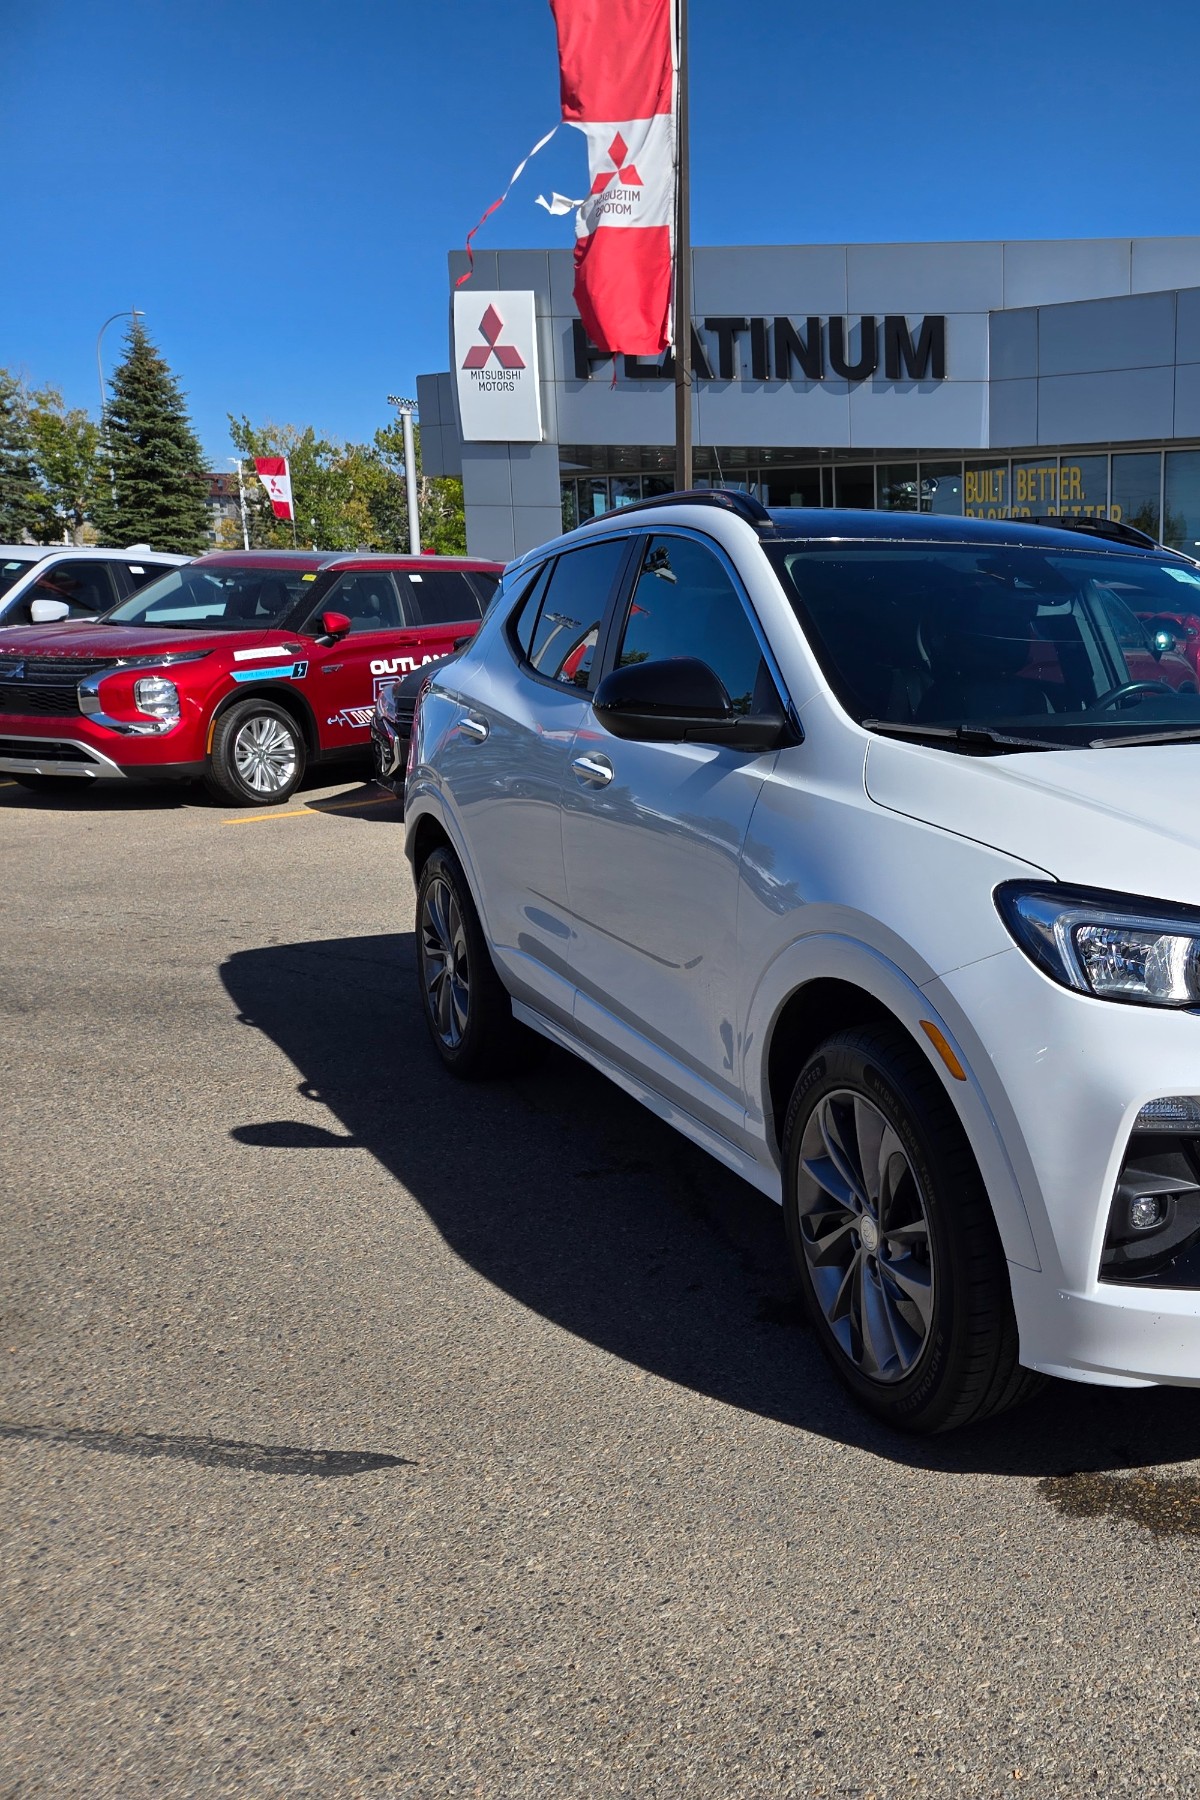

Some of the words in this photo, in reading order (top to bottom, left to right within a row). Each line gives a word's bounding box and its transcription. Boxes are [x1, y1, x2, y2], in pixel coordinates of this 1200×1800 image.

[470, 370, 521, 380] MITSUBISHI
[478, 381, 515, 392] MOTORS
[965, 469, 1006, 504] BUILT
[1016, 466, 1085, 502] BETTER.
[370, 653, 449, 675] OUTLA
[785, 1066, 822, 1138] MOTOMASTER
[873, 1078, 900, 1115] HYDRA
[921, 1165, 937, 1206] TOUR
